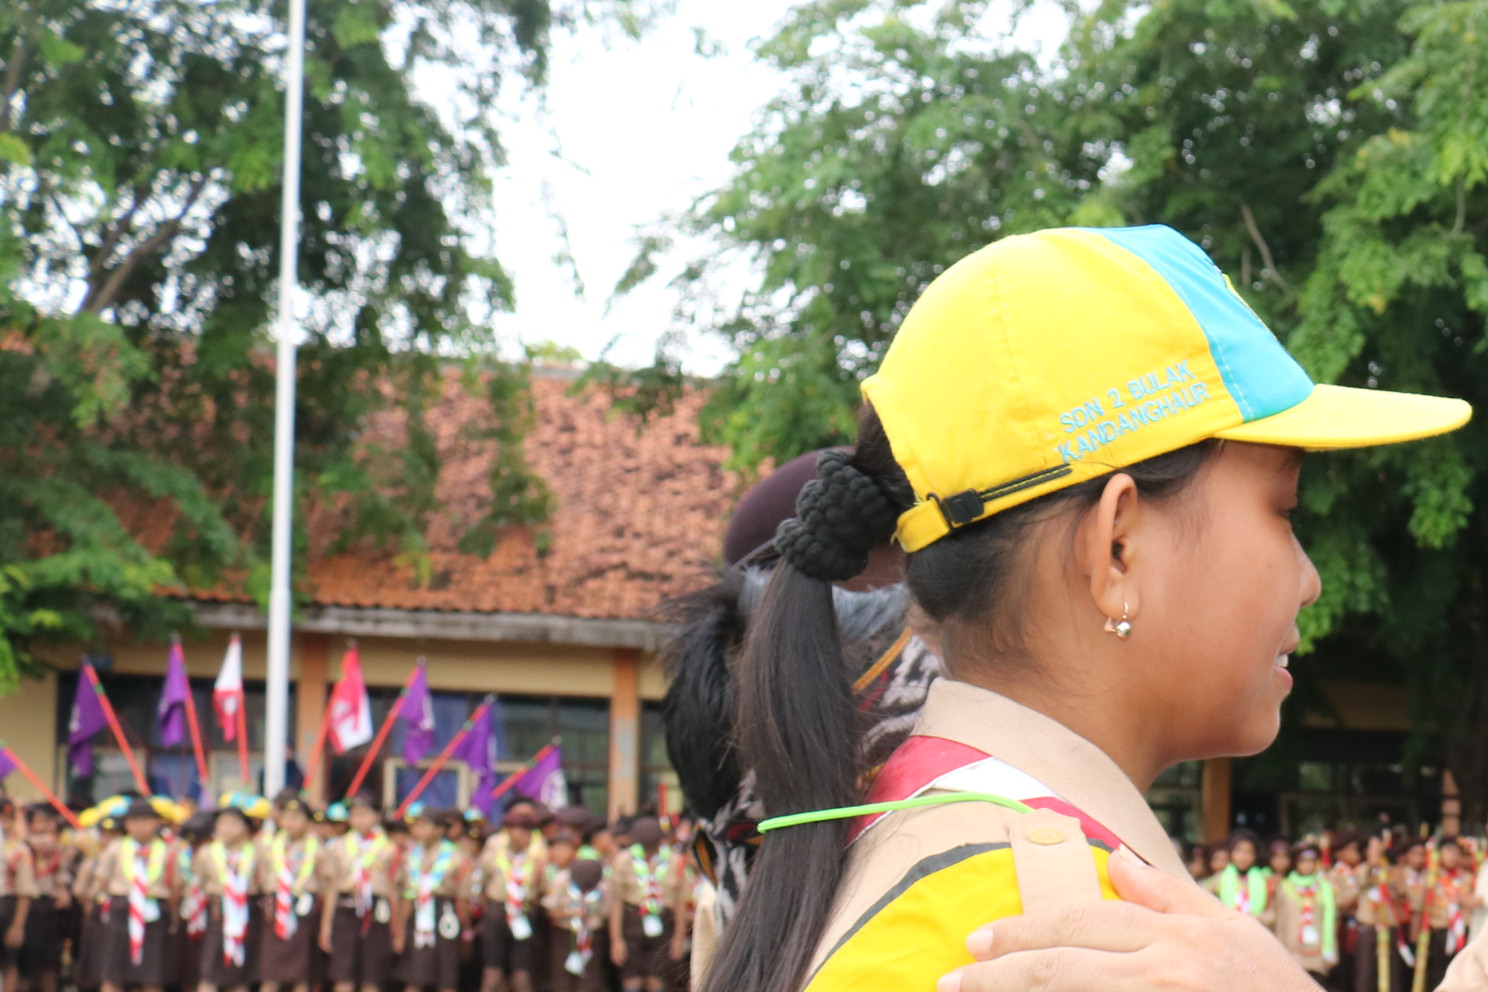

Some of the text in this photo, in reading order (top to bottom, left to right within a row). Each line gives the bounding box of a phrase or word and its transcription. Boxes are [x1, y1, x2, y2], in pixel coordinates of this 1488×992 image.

[1057, 382, 1210, 464] KANDANGHAUR
[1060, 359, 1196, 433] SDN 2 BULAK
